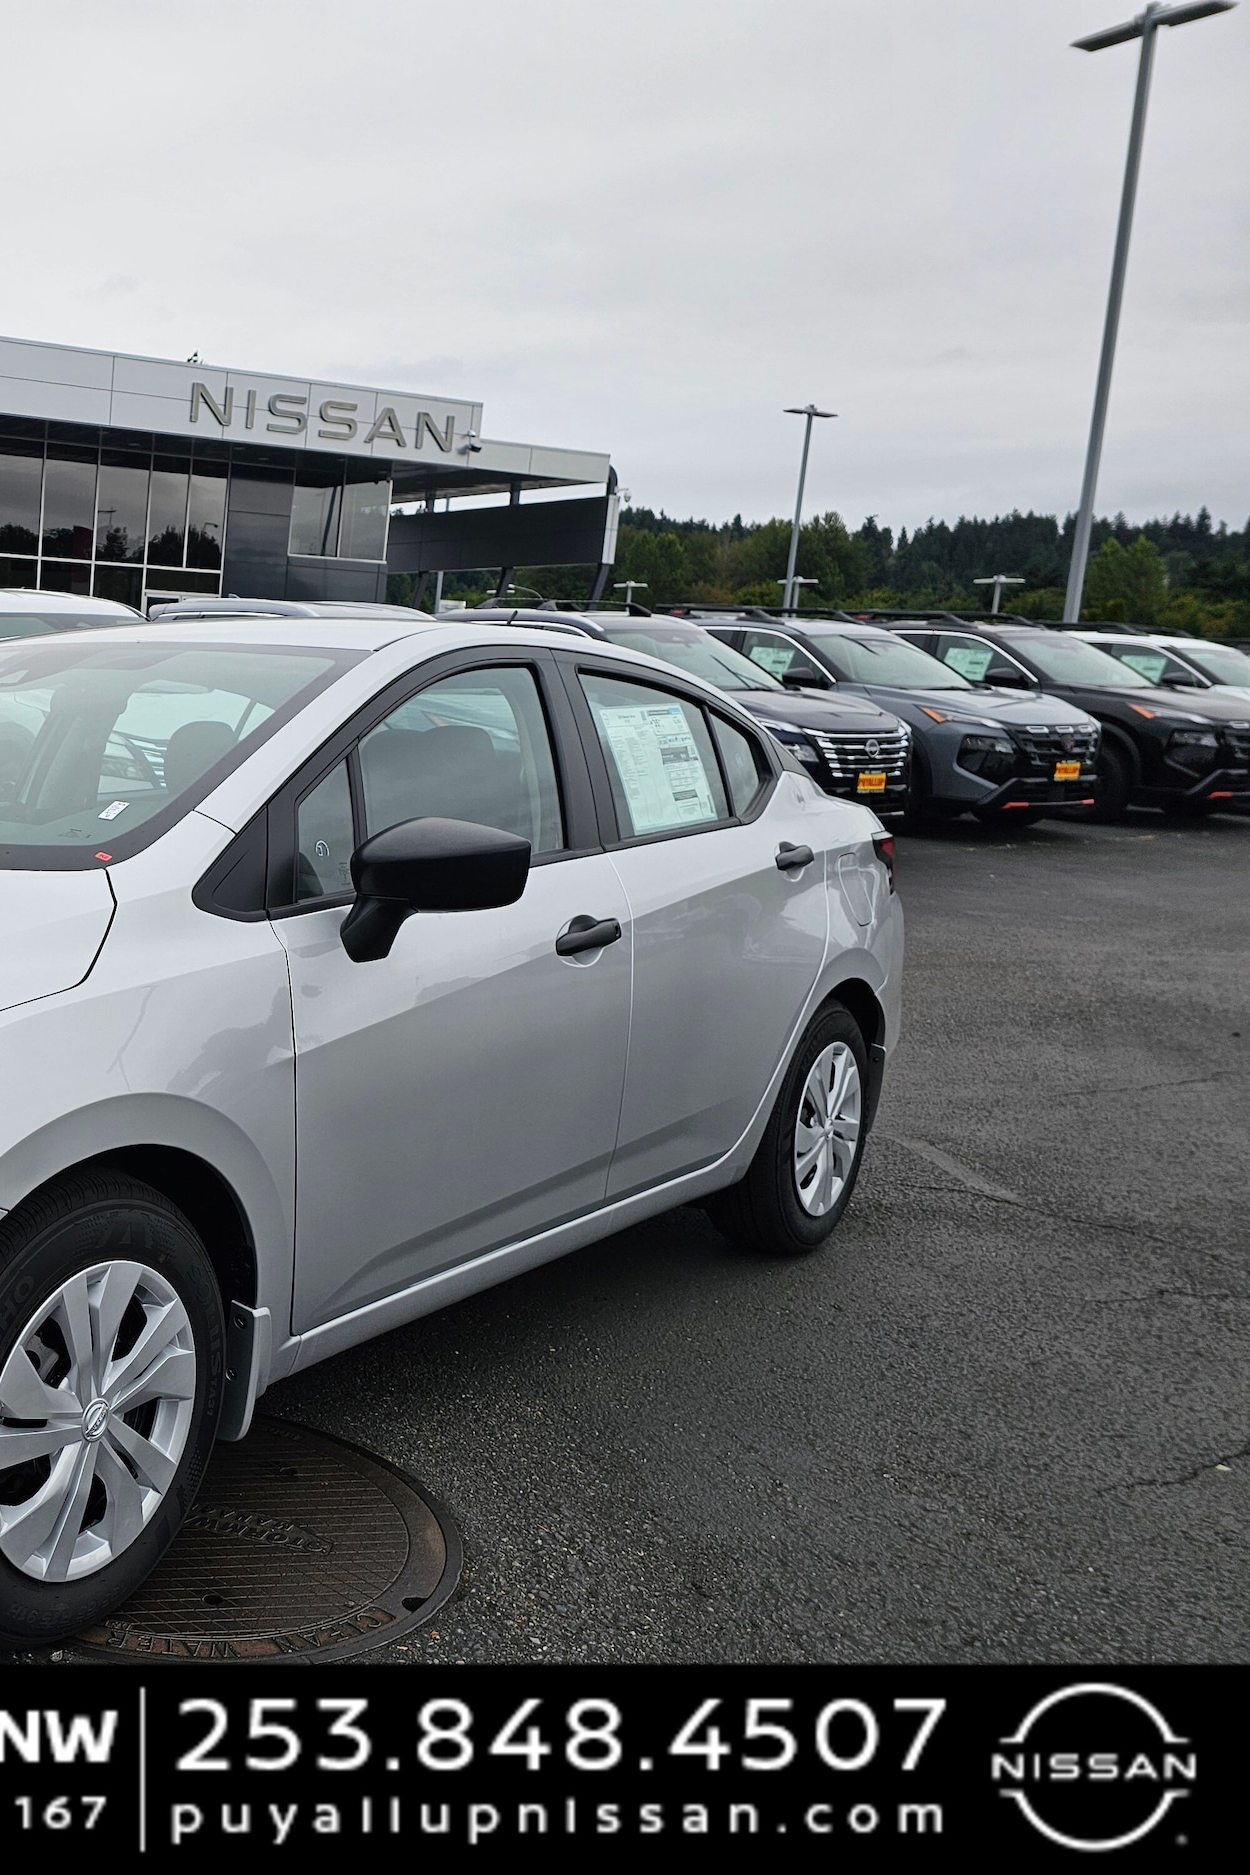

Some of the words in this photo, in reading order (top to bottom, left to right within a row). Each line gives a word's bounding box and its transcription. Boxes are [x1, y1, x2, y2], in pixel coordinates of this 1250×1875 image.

[190, 382, 456, 453] NISSAN
[104, 1630, 239, 1659] WATER
[273, 1611, 385, 1654] CLEAN
